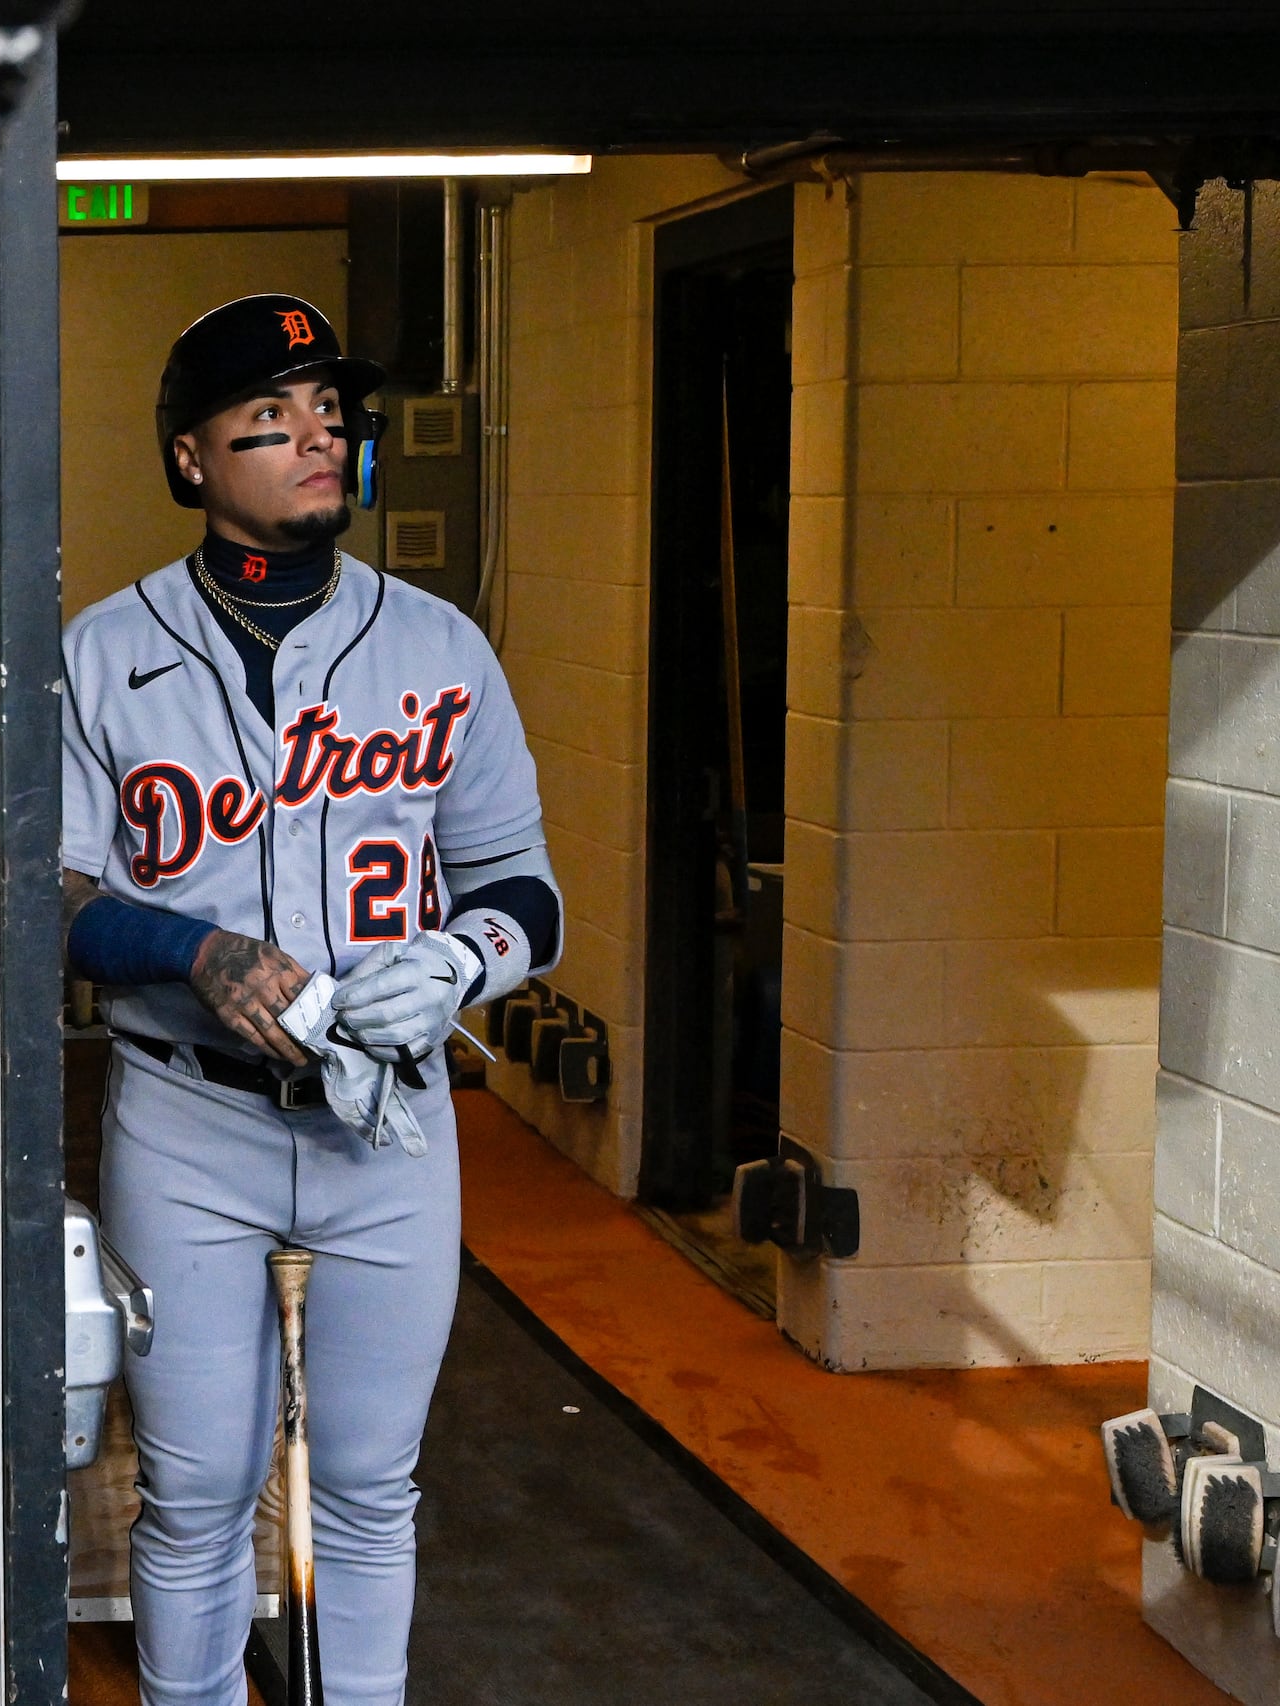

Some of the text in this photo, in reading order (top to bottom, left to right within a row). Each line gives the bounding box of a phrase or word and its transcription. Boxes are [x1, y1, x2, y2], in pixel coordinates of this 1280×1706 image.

[273, 310, 315, 350] D
[239, 552, 267, 583] D
[120, 682, 472, 889] Detroit
[344, 832, 443, 945] 28
[483, 926, 509, 957] 28
